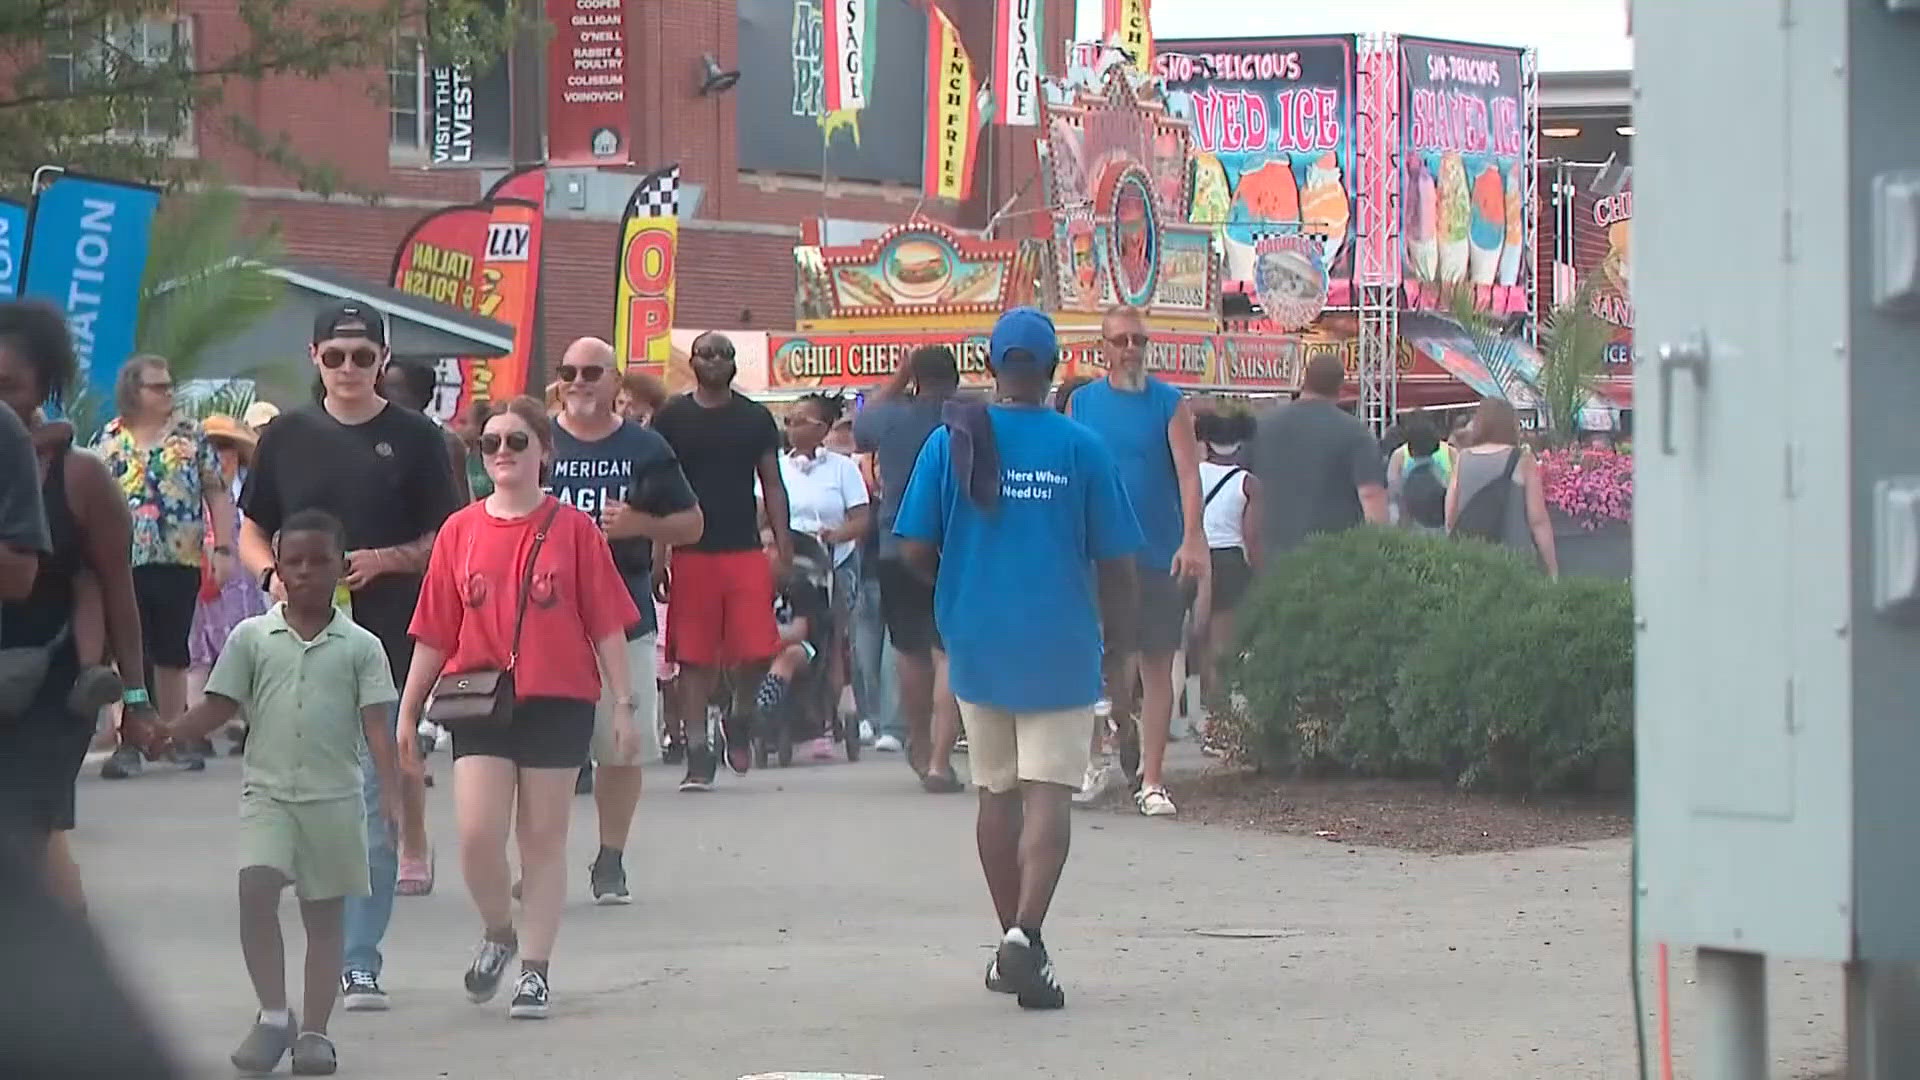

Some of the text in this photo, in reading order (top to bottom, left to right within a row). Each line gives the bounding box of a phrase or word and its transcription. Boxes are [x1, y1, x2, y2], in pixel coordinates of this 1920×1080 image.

[571, 15, 621, 26] GILLIGAN
[580, 31, 622, 42] O'NEILL
[573, 48, 623, 58] RABBIT &
[574, 59, 624, 70] POULTRY
[567, 75, 624, 86] COLISEUM
[563, 91, 624, 103] VOINOVICH
[433, 66, 451, 163] VISIT THE
[452, 63, 473, 162] LIVEST
[1190, 86, 1340, 152] VED ICE
[1413, 87, 1521, 156] SHAVED ICE
[944, 113, 960, 187] FRIES
[488, 227, 529, 256] LLY
[624, 227, 675, 377] OP
[790, 344, 844, 376] CHILI
[1179, 343, 1207, 372] FRIES
[1602, 344, 1627, 364] ICE
[1230, 357, 1290, 379] SAUSAGE
[554, 460, 632, 477] MERICAN
[1006, 469, 1034, 483] Here
[1035, 471, 1068, 486] When
[1002, 486, 1052, 500] Need Us!
